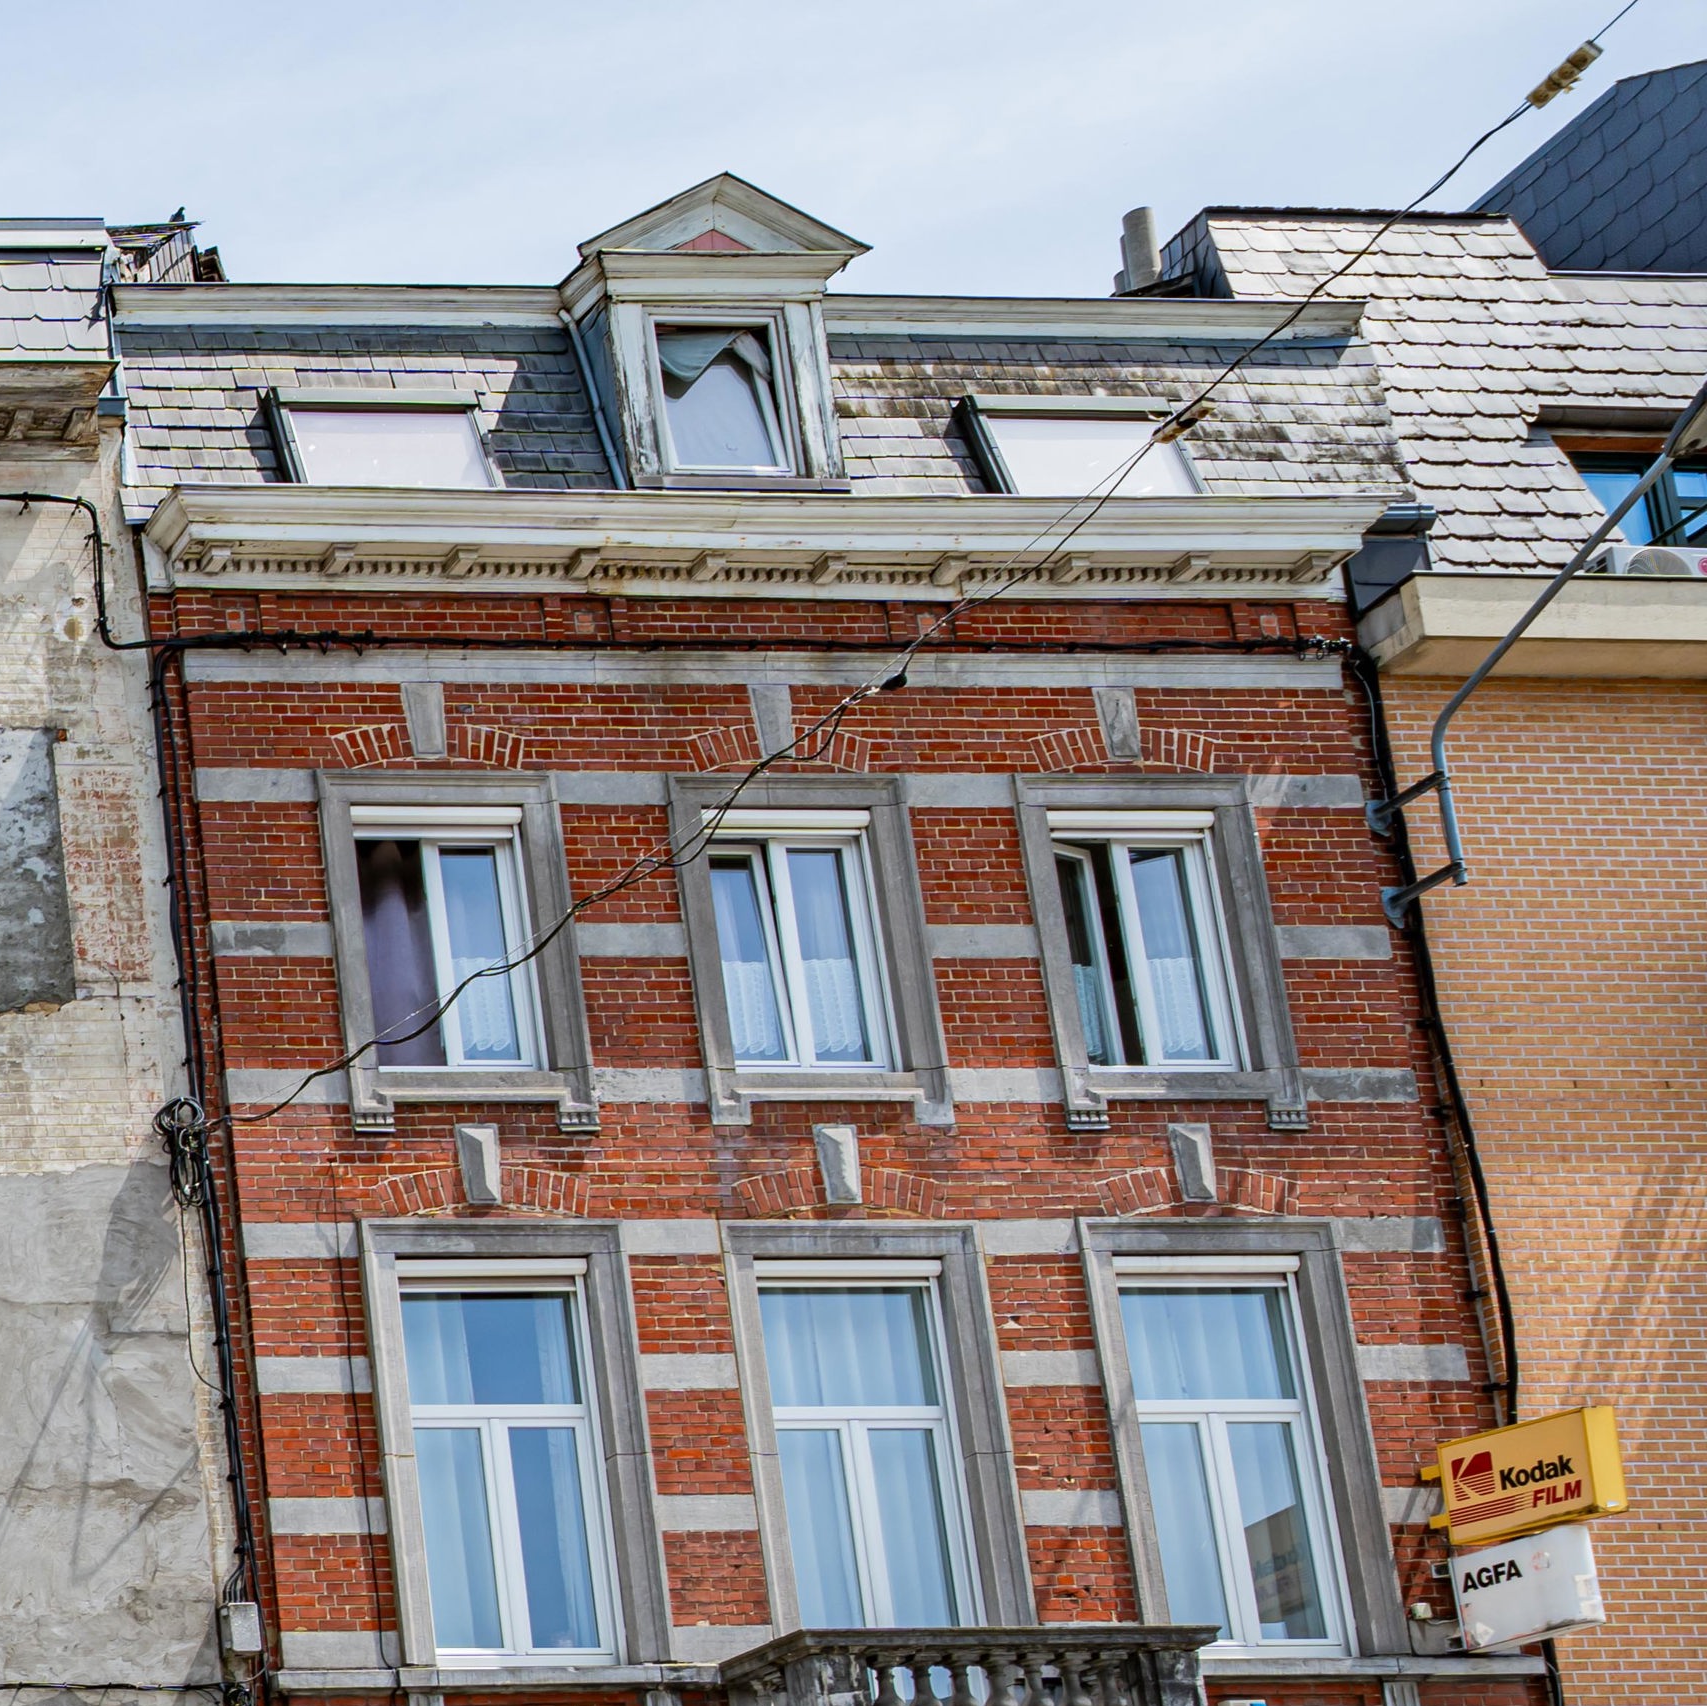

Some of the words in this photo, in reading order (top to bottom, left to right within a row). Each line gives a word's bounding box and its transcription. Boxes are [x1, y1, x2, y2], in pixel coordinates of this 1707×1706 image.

[1499, 1455, 1575, 1490] Kodak
[1532, 1479, 1582, 1508] FILM
[1462, 1559, 1523, 1593] AGFA
